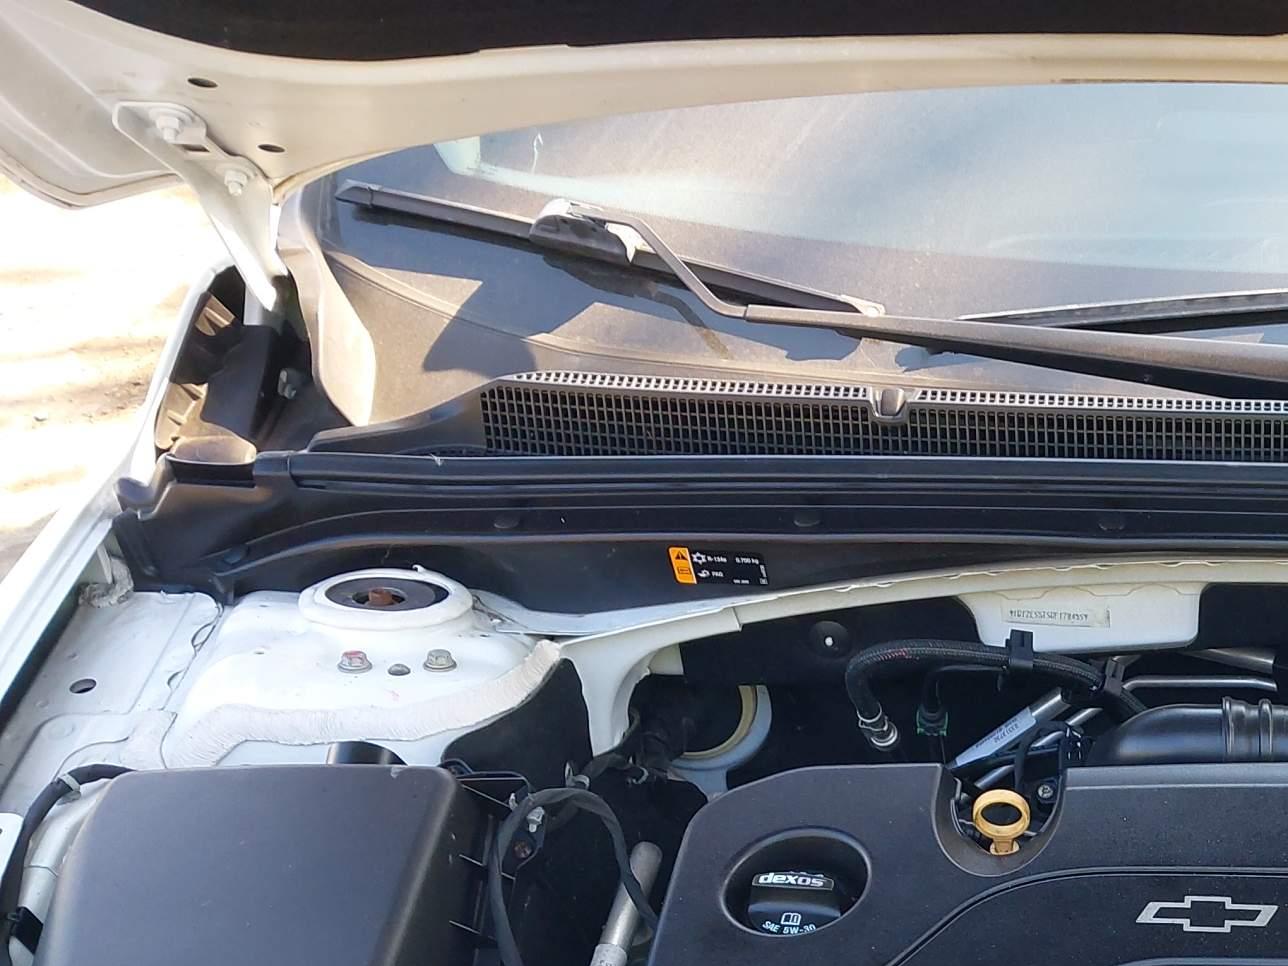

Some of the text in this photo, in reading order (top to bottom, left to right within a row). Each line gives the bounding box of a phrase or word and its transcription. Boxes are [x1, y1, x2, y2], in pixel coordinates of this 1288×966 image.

[758, 872, 825, 887] dexos
[762, 920, 817, 935] SAE 5W-30
